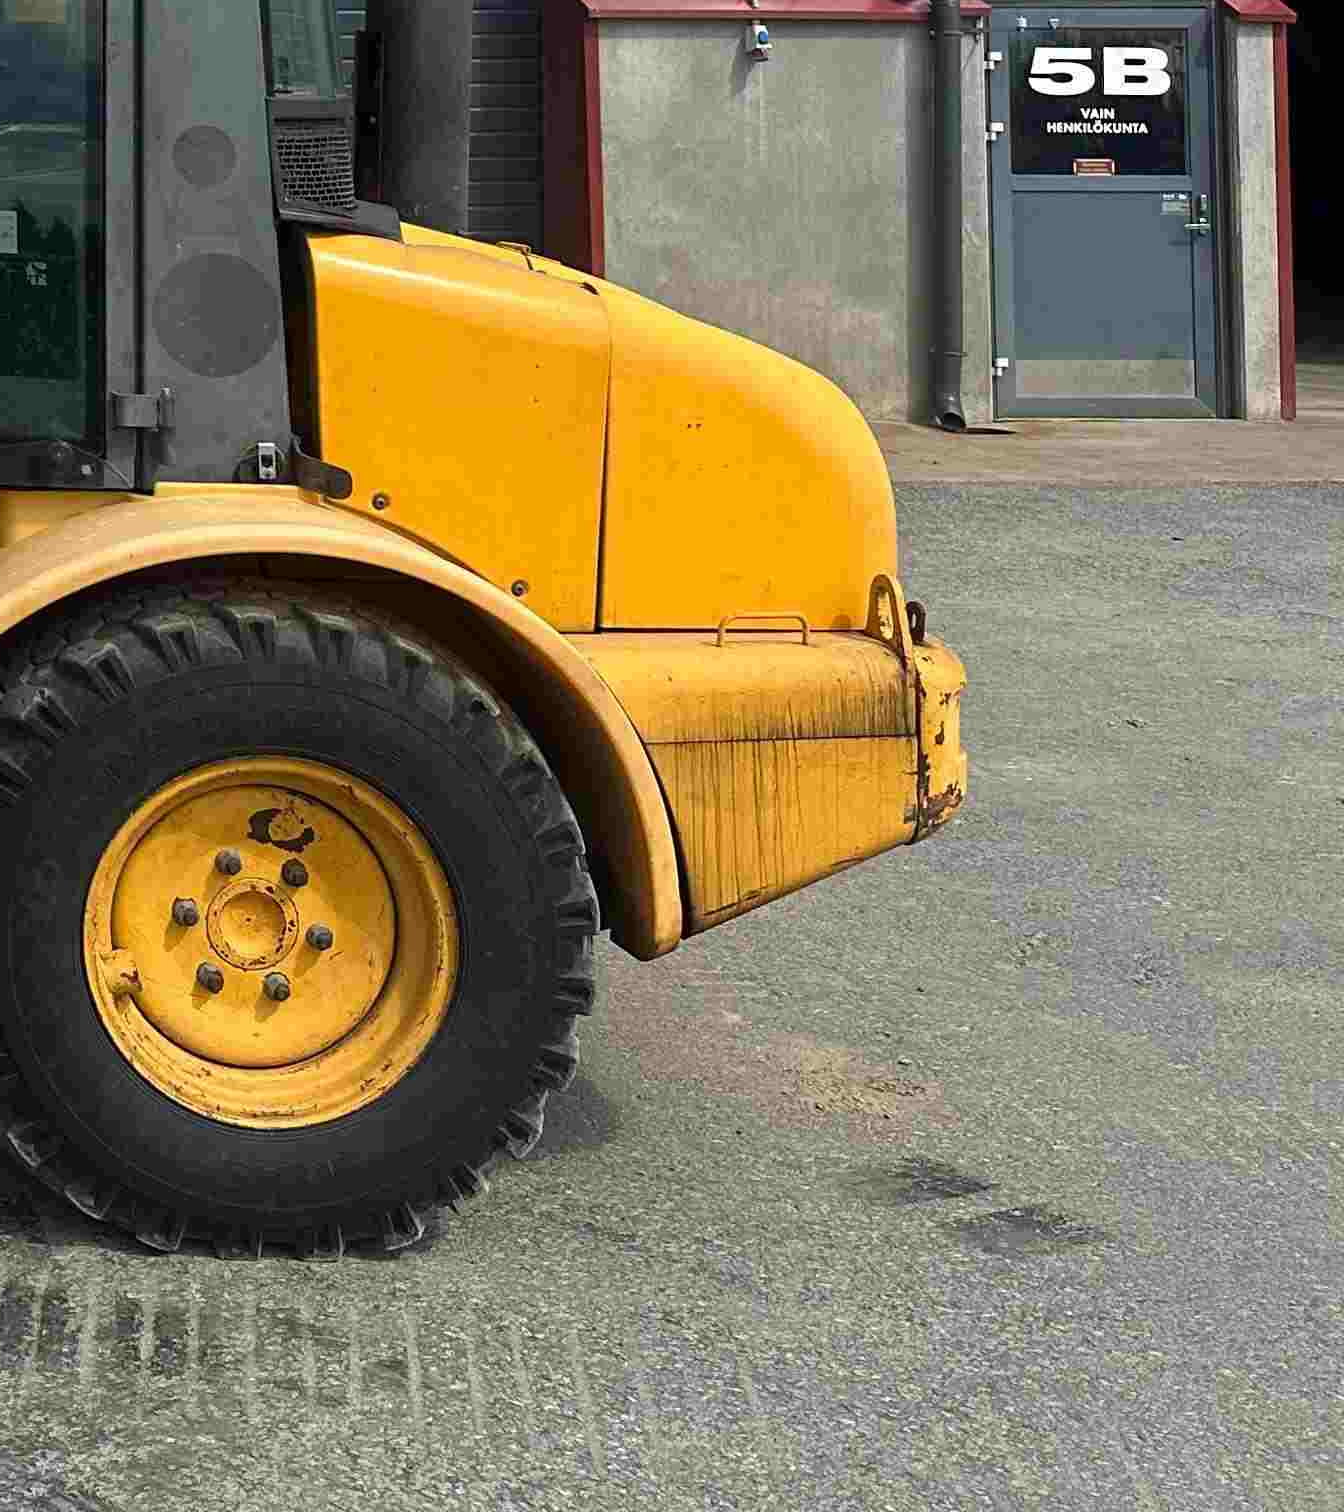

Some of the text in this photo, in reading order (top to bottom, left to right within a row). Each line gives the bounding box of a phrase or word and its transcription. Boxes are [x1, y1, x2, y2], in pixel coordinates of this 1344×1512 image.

[1028, 46, 1172, 96] 5B
[1080, 107, 1115, 120] VAIN
[1046, 119, 1149, 134] HENKILÖKUNTA
